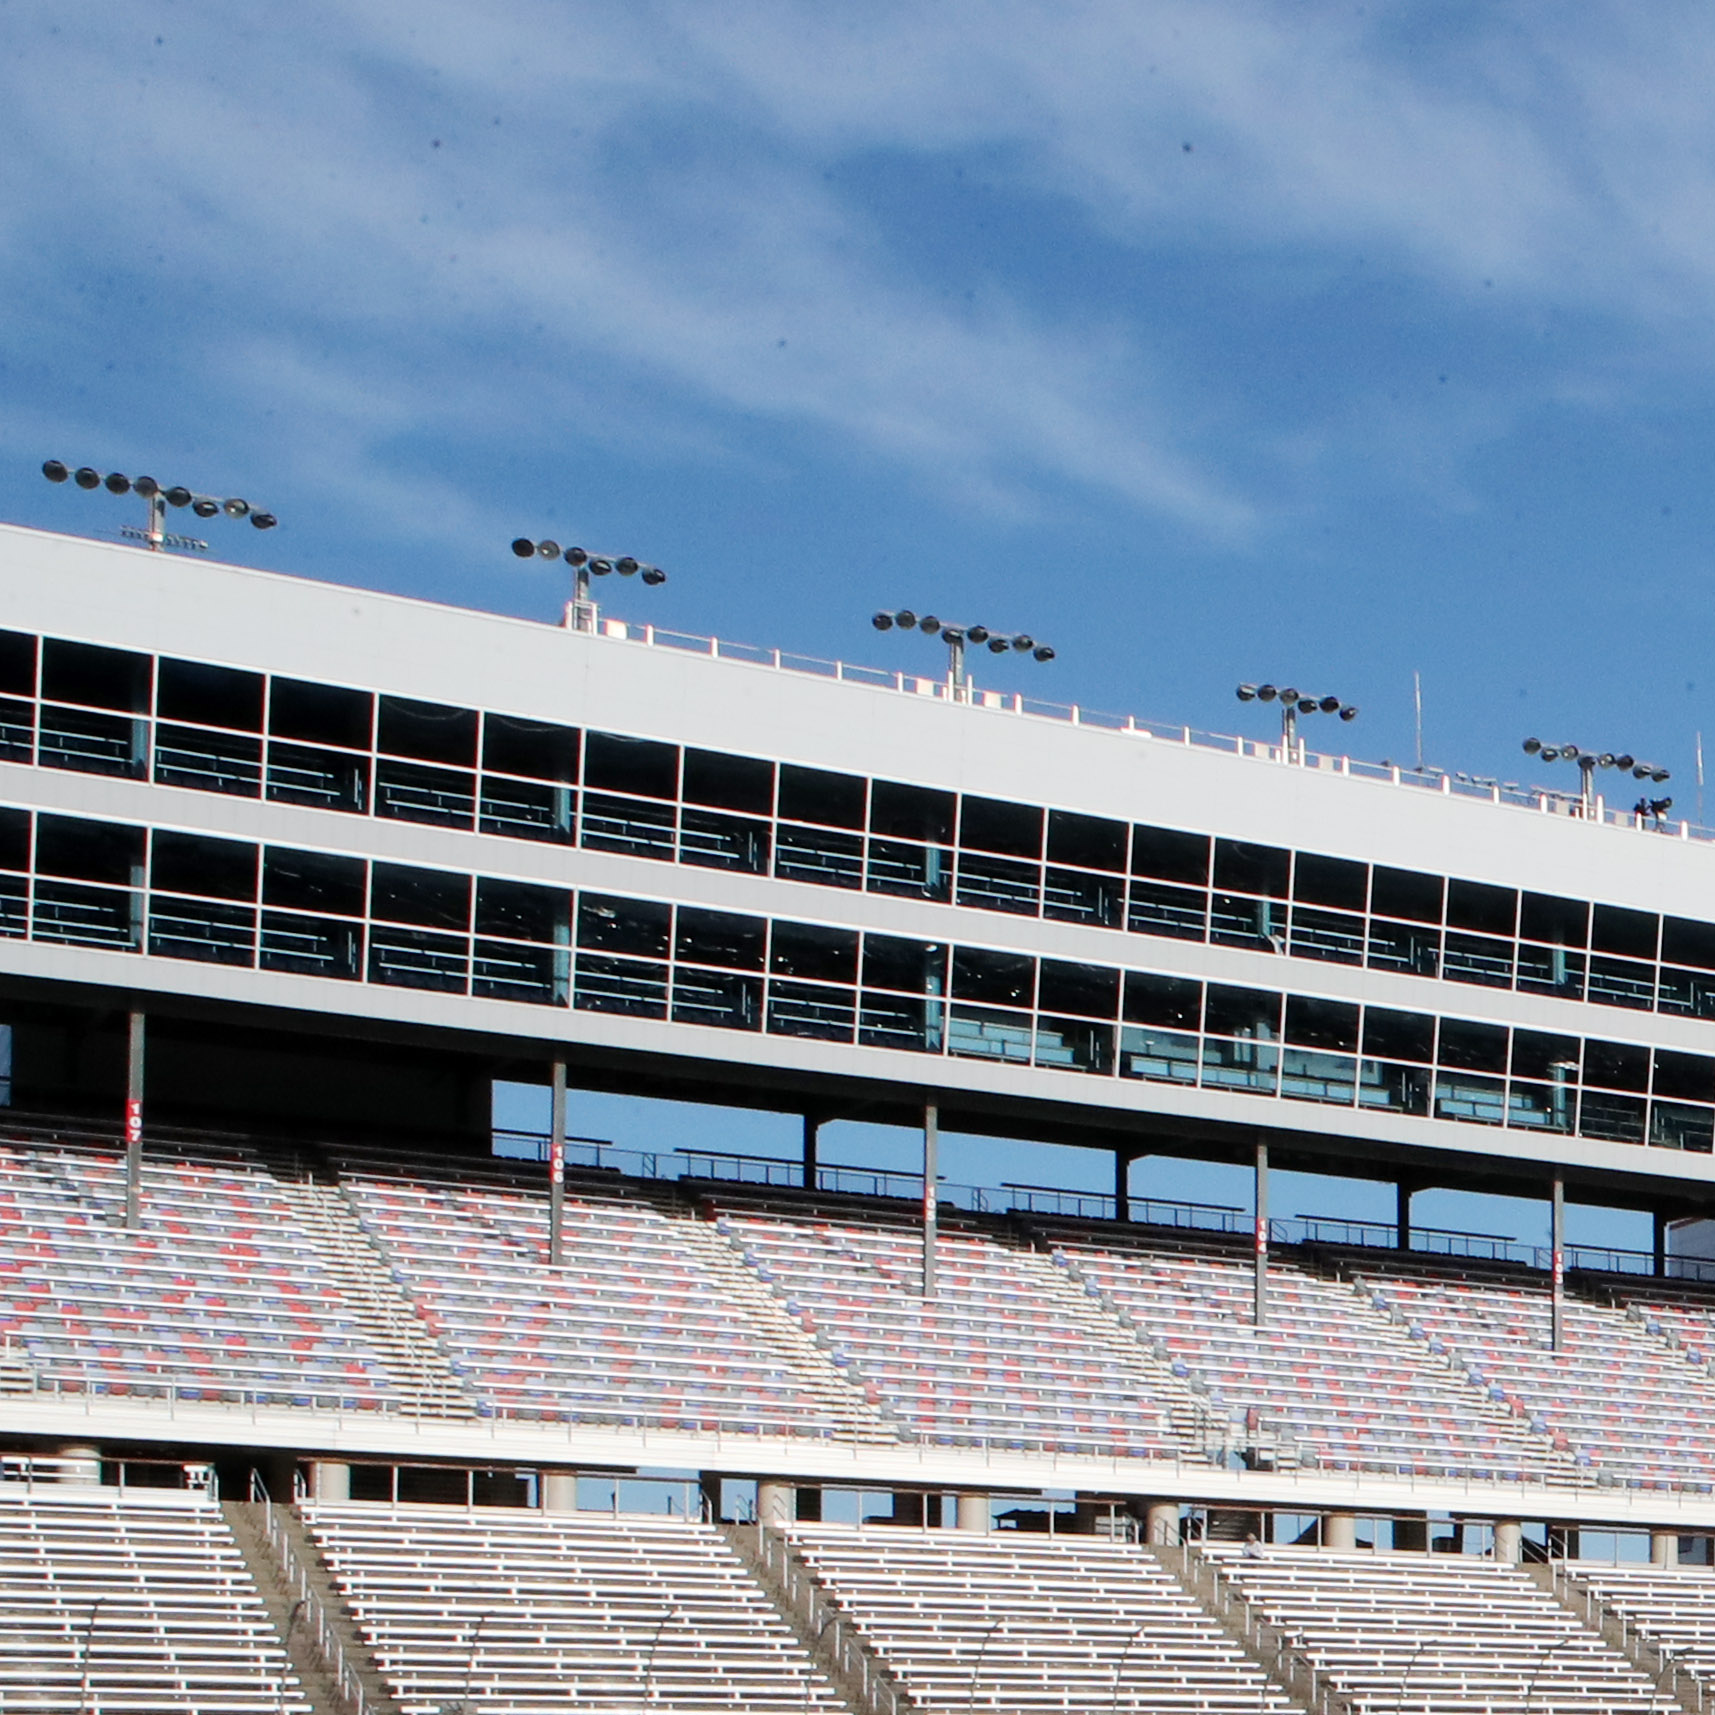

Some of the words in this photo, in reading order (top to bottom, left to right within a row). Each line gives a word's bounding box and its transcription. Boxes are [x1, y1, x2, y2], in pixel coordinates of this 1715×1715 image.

[129, 1102, 142, 1141] 107
[553, 1145, 565, 1183] 106
[925, 1186, 936, 1221] 105
[1258, 1219, 1267, 1253] 104
